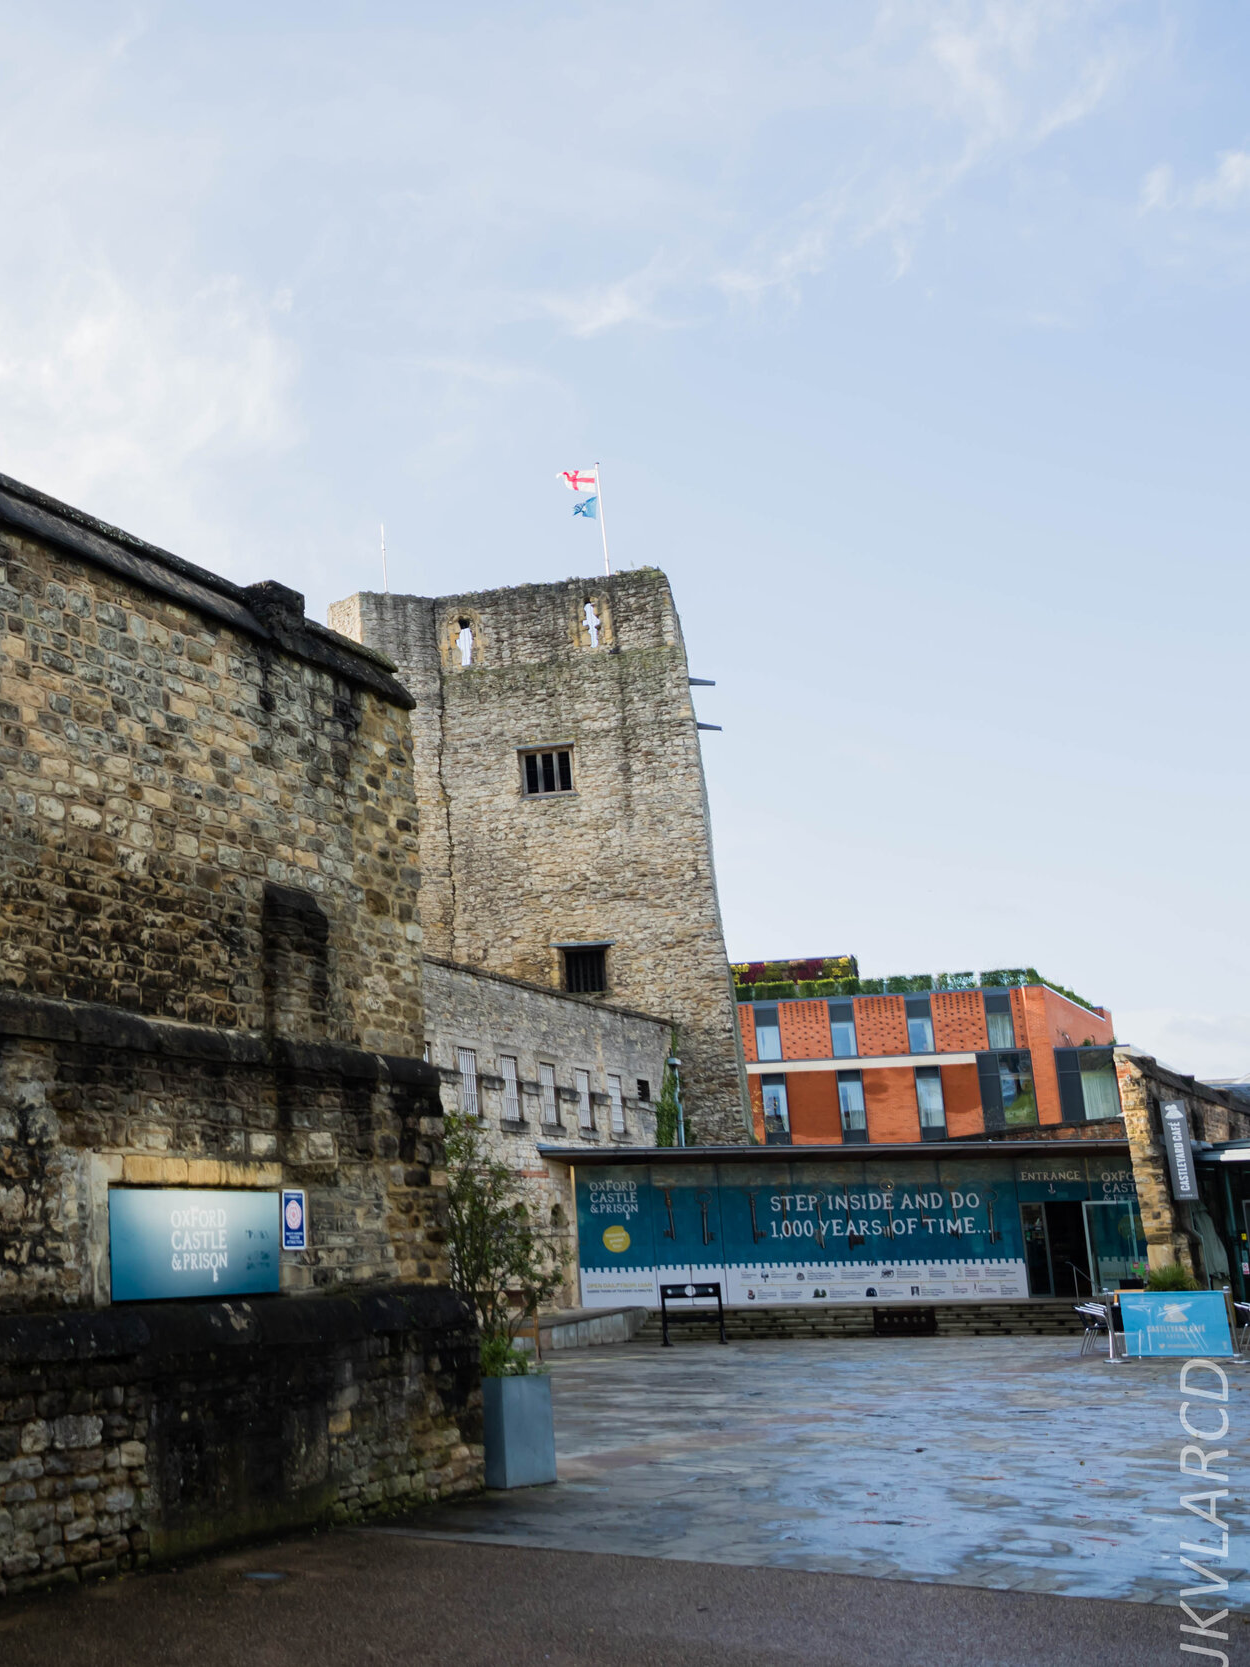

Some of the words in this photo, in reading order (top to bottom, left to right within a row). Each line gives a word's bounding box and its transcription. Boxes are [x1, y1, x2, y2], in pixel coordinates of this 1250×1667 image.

[1167, 1121, 1183, 1141] CAFÉ
[1020, 1170, 1080, 1181] ENTRANCE
[1101, 1170, 1135, 1182] OXFO
[1173, 1143, 1190, 1191] CASTLEYARD
[589, 1180, 637, 1192] OXFORD
[1102, 1182, 1136, 1193] CAST
[589, 1192, 638, 1203] CASTLE
[770, 1195, 818, 1212] STEP
[827, 1193, 894, 1211] INSIDE
[900, 1192, 944, 1210] AND
[950, 1191, 980, 1209] DO
[170, 1206, 227, 1228] OXFORD
[600, 1203, 639, 1217] PRISON
[770, 1220, 814, 1240] 1,000
[818, 1218, 882, 1236] YEARS
[892, 1217, 918, 1235] OF
[171, 1229, 228, 1250] CASTLE
[171, 1252, 182, 1271] &
[183, 1252, 228, 1280] PRISON
